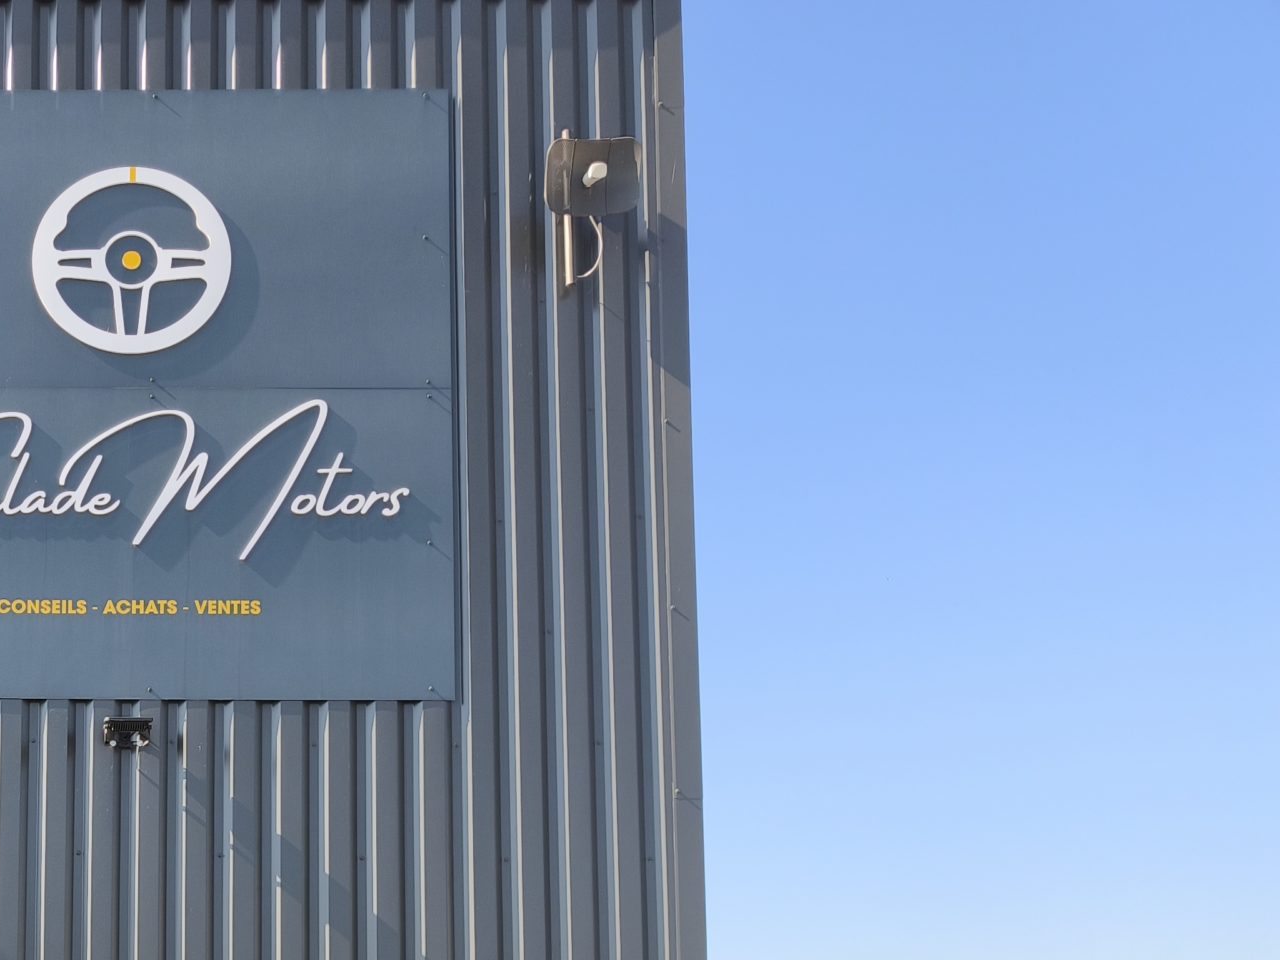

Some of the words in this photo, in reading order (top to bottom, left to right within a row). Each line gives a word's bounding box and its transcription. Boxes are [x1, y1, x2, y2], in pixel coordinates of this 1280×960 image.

[59, 398, 410, 560] Motors
[103, 599, 178, 615] ACHATS
[194, 599, 262, 616] VENTES
